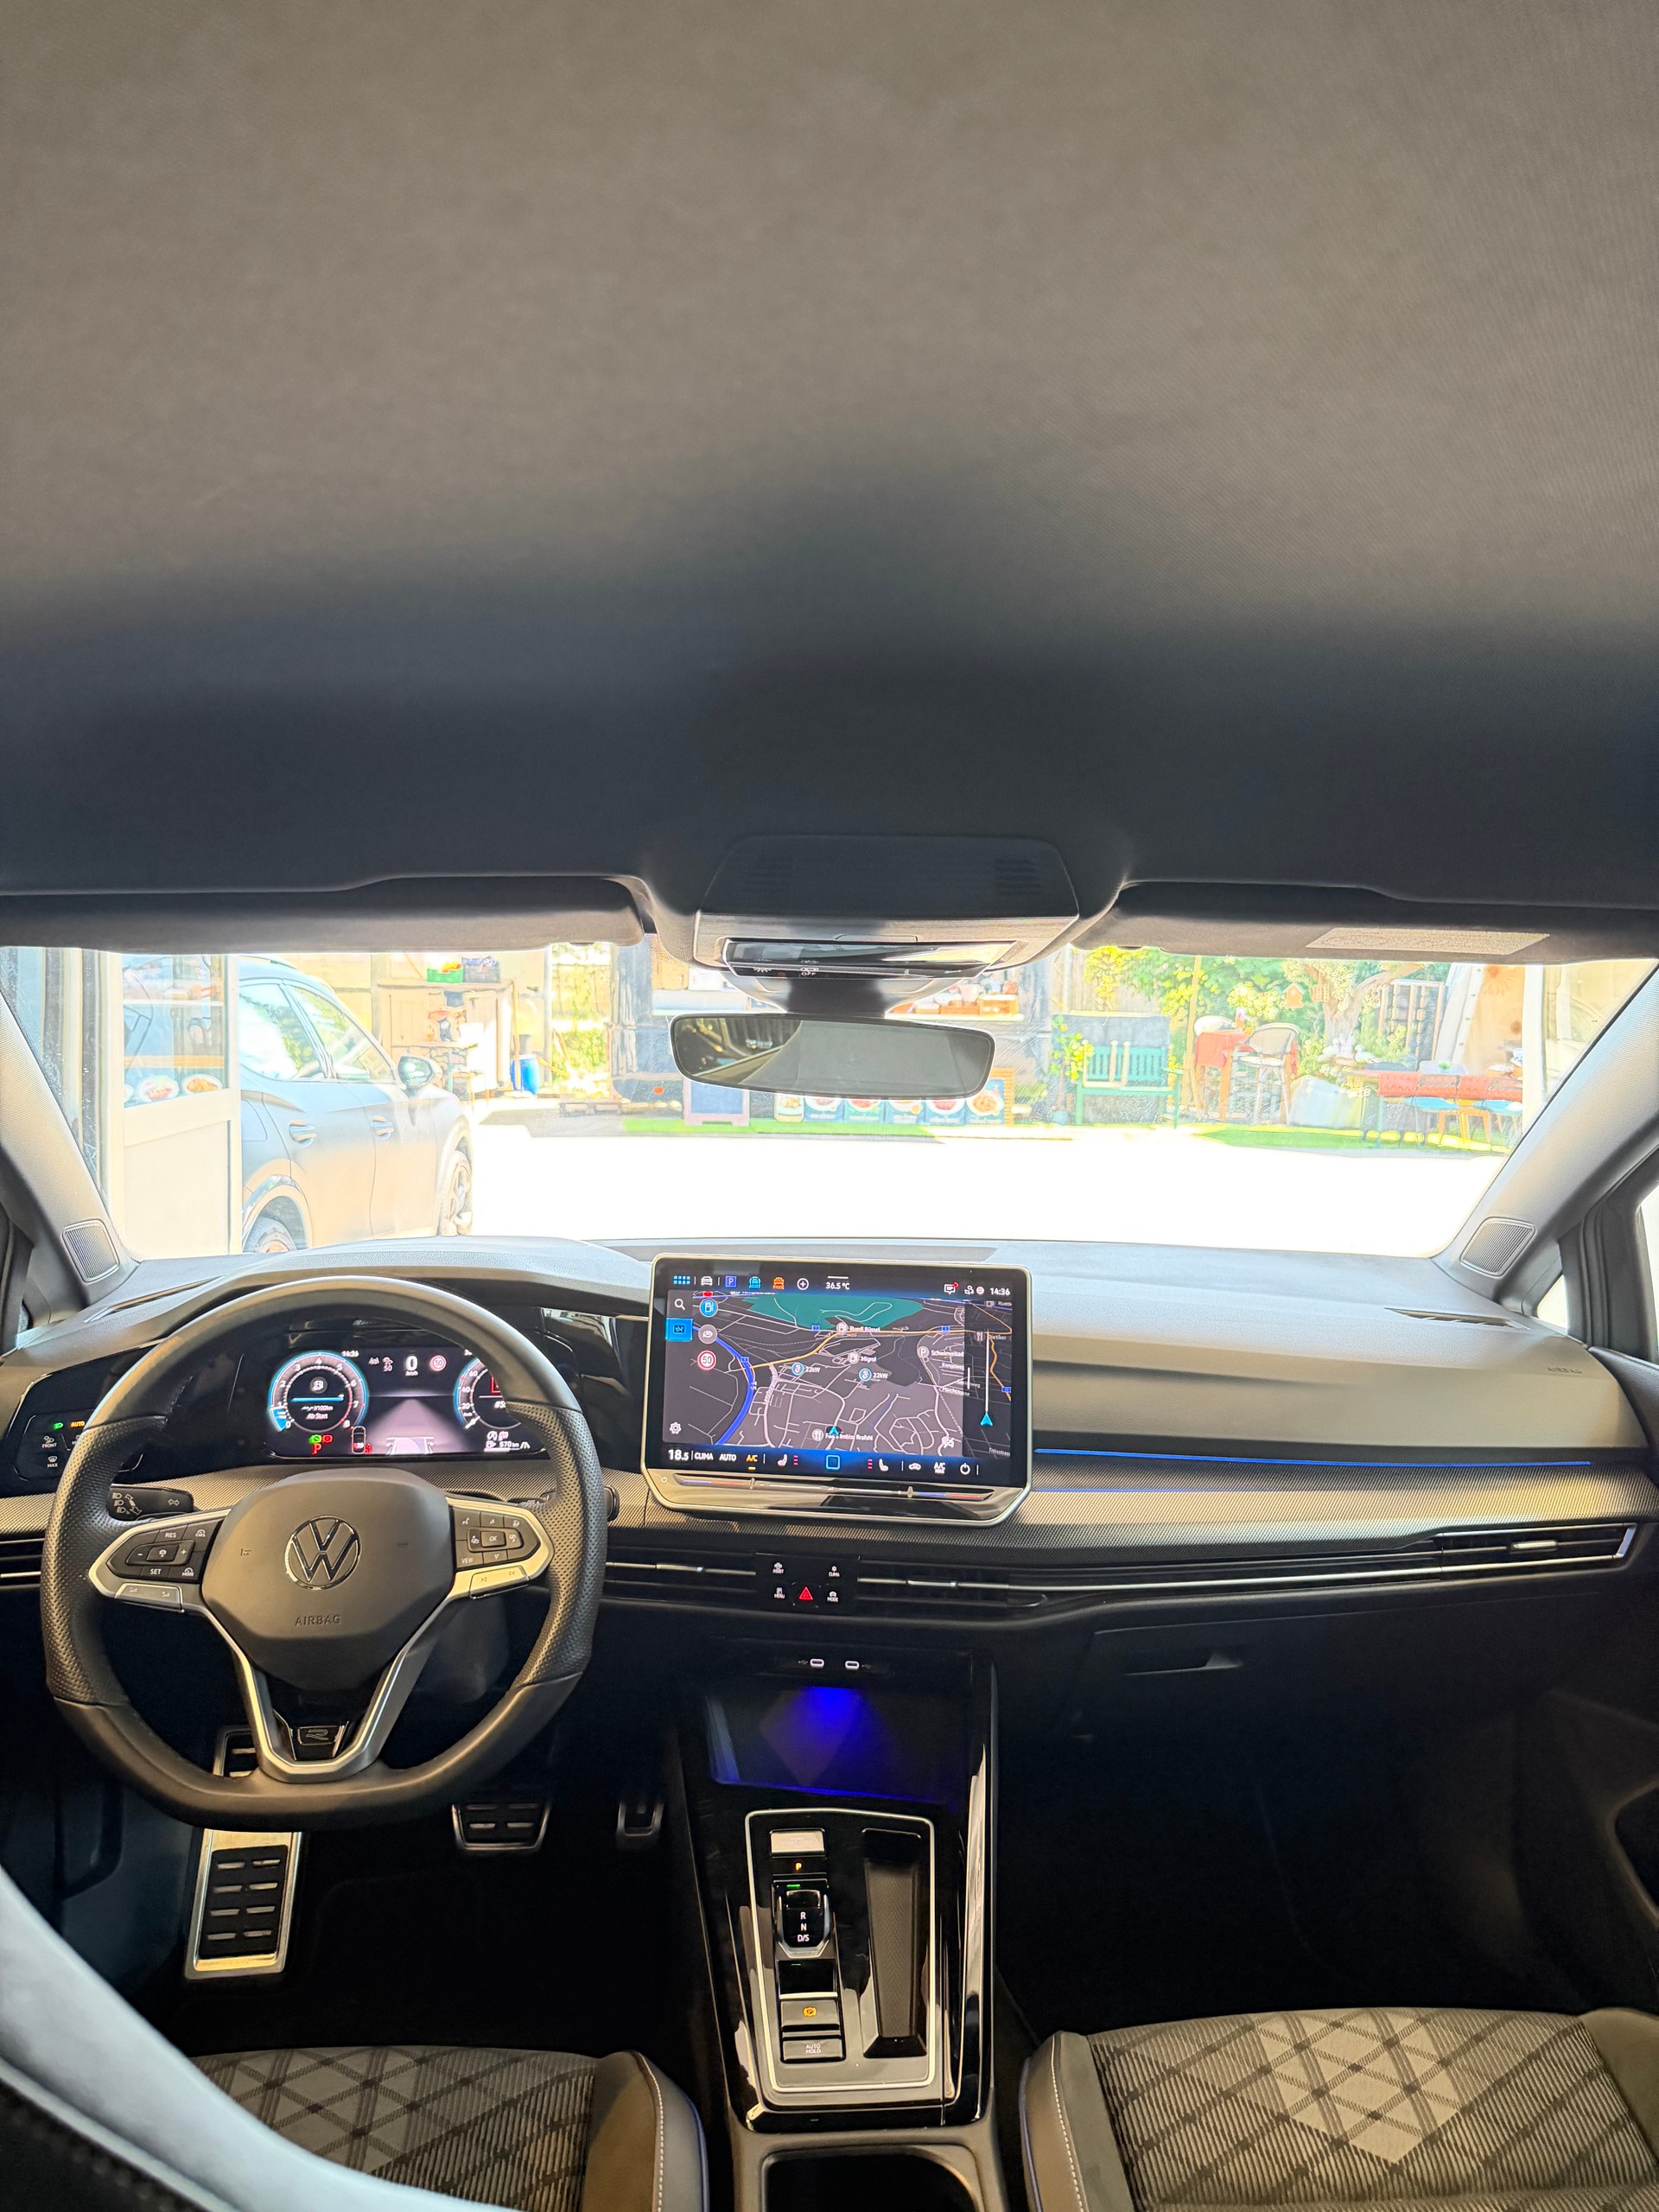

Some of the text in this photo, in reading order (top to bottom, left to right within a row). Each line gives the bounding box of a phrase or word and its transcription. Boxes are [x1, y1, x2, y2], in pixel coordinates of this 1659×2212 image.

[405, 1355, 418, 1370] 0
[702, 1356, 712, 1364] 50
[312, 1443, 321, 1453] P
[668, 1449, 690, 1461] 18.5
[295, 1614, 341, 1626] AIRBAG
[795, 1862, 803, 1872] P
[800, 1911, 807, 1920] R
[800, 1923, 807, 1931] N
[797, 1934, 810, 1942] D/S
